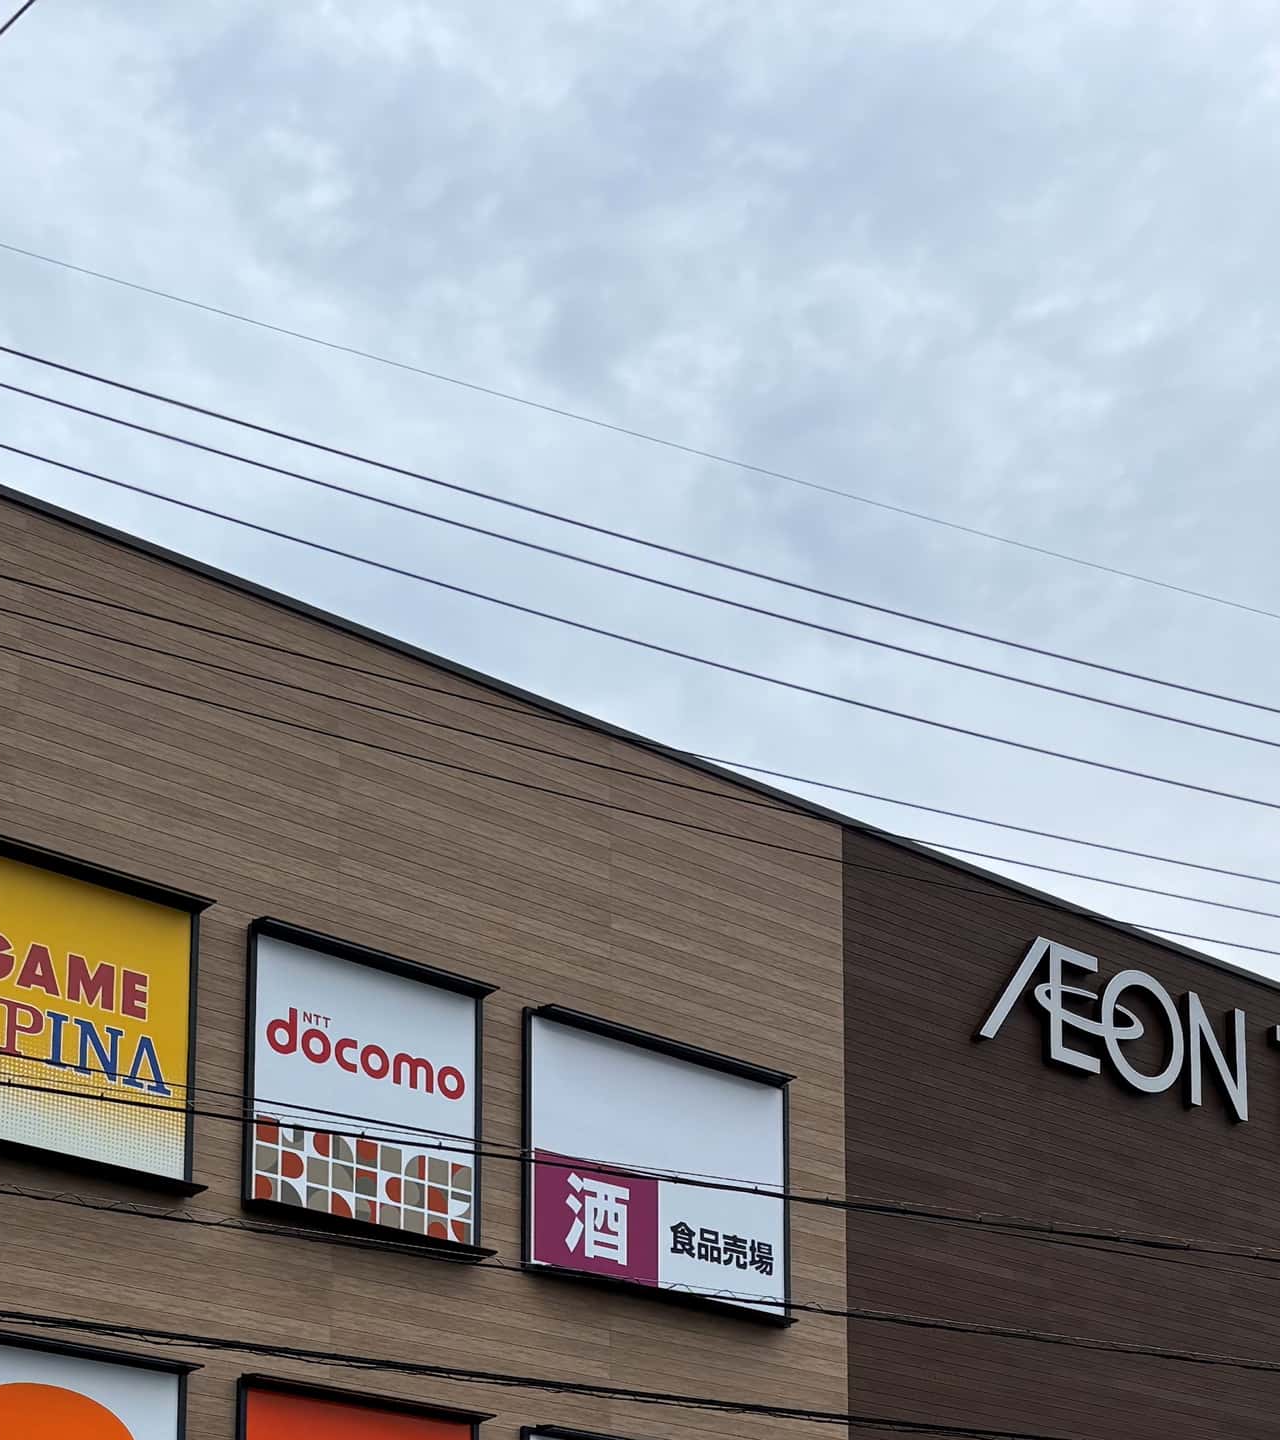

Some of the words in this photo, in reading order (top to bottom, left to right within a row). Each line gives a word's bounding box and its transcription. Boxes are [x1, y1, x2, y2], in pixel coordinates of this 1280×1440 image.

[266, 1007, 466, 1101] docomo
[302, 1011, 332, 1029] NTT
[564, 1171, 630, 1267] 酒
[669, 1220, 774, 1278] 食品売場
